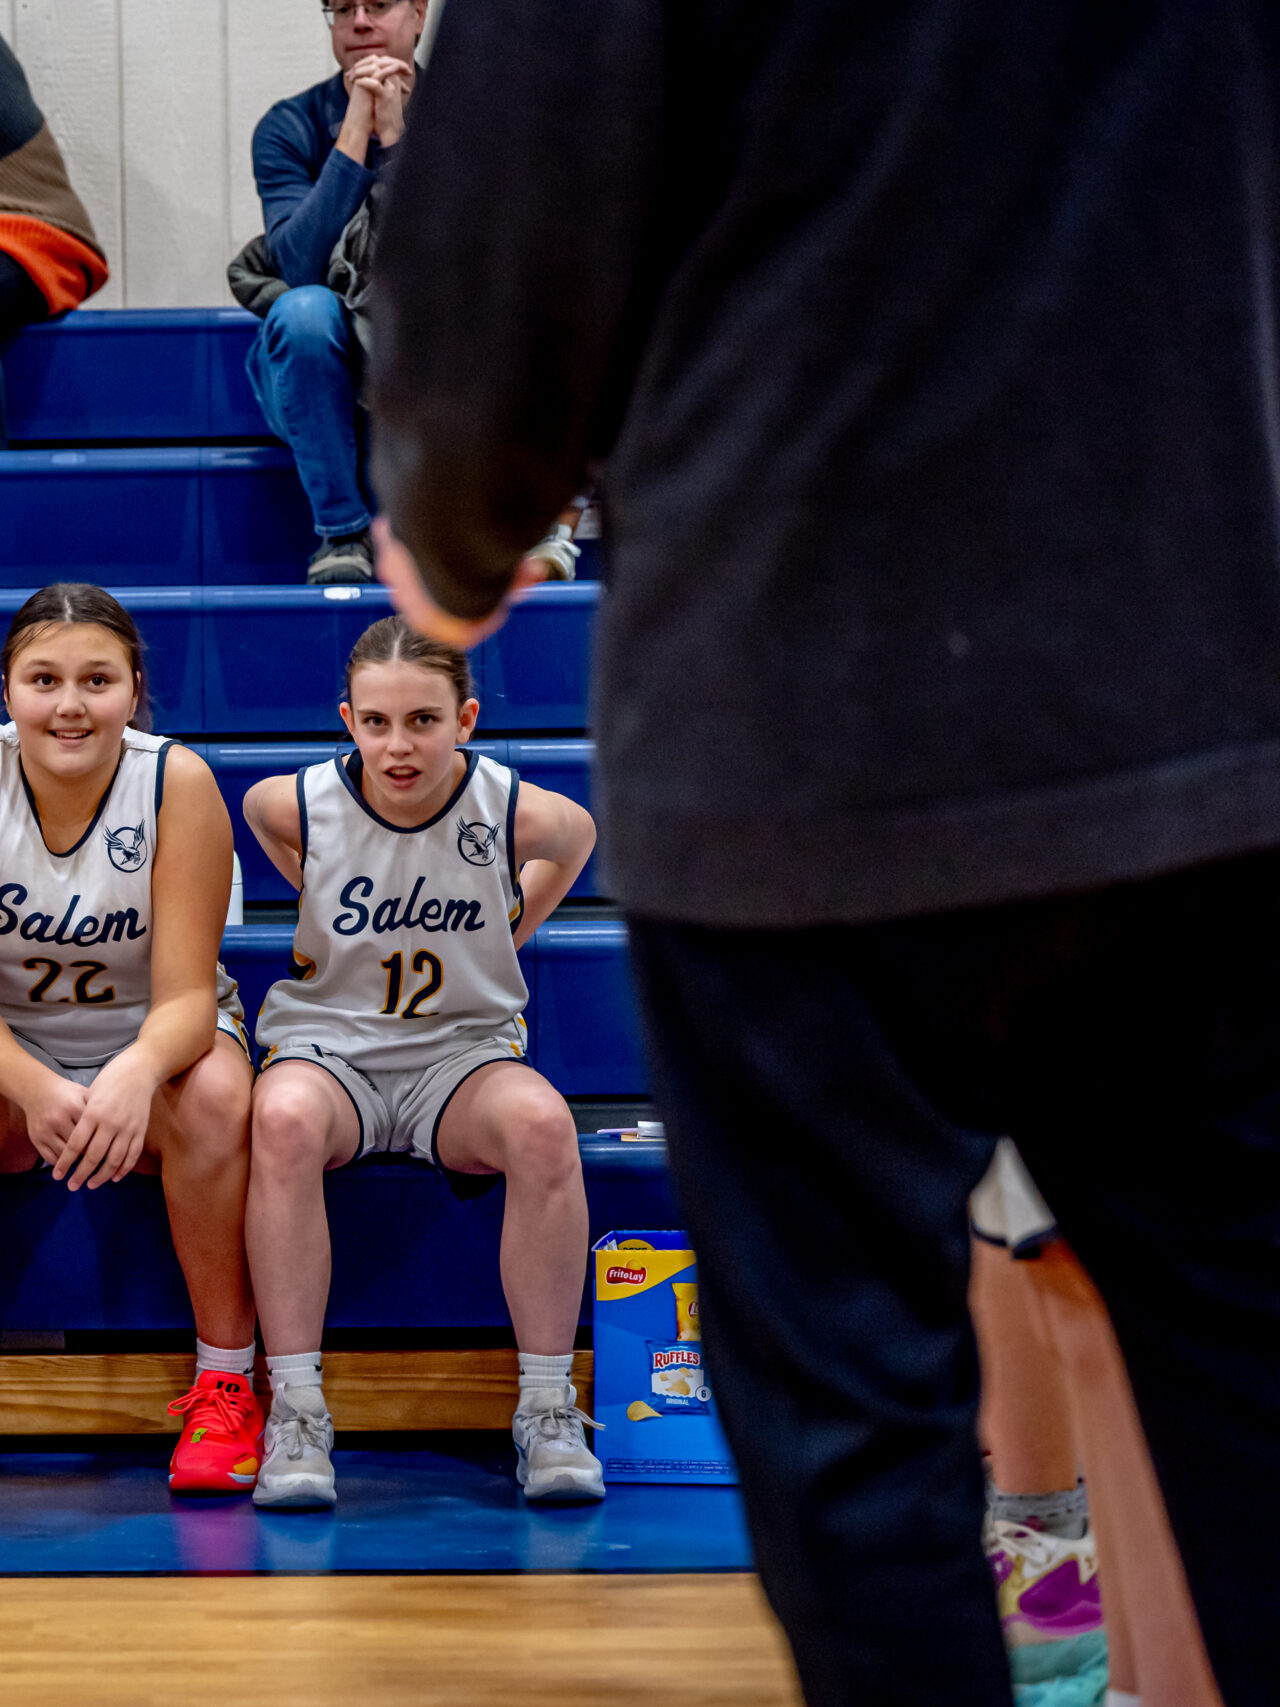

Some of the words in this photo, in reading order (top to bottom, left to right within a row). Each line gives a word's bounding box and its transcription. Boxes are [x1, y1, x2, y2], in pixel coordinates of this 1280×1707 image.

[332, 876, 485, 935] Salem
[22, 956, 115, 1004] 22
[380, 948, 444, 1019] 12
[653, 1350, 700, 1369] RUFFLES
